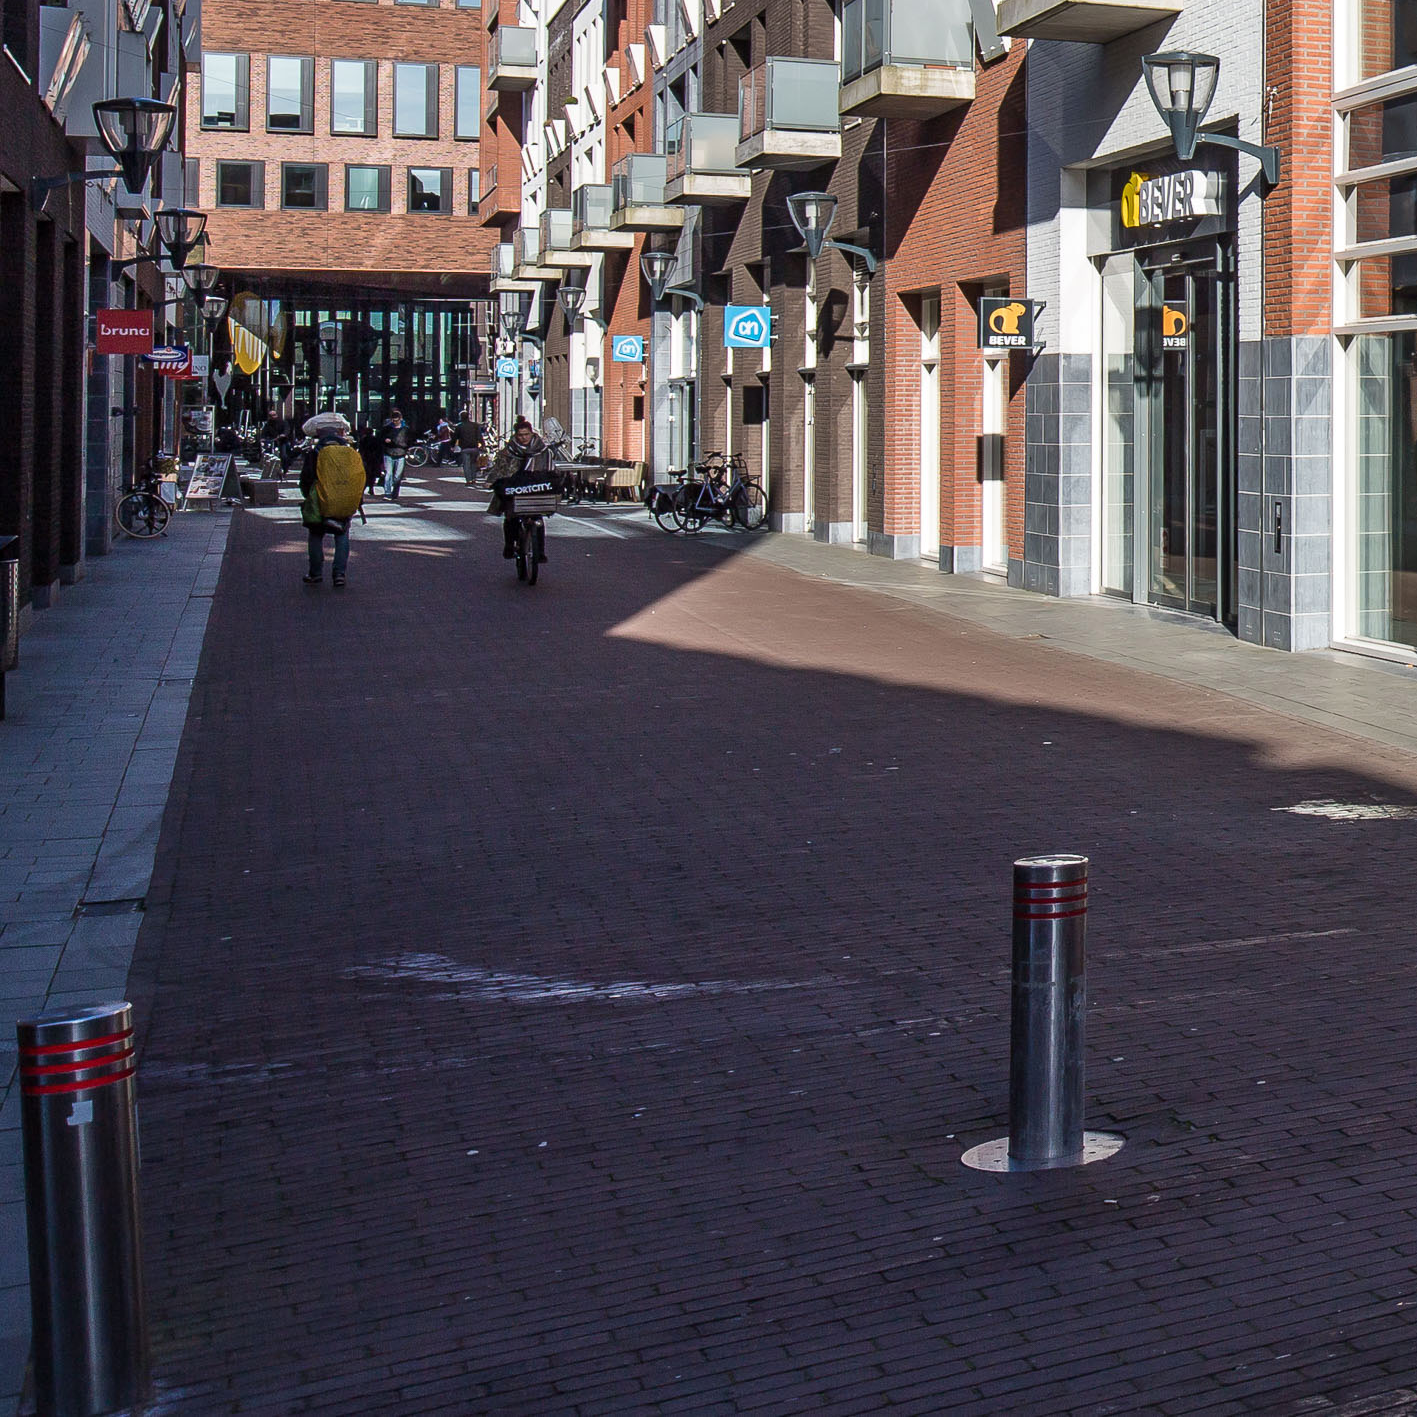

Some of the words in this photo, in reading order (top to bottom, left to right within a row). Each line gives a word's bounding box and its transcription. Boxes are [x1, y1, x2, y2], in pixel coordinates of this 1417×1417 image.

[1139, 170, 1194, 225] BEVER
[100, 324, 150, 336] bruna
[989, 335, 1026, 346] BEVER
